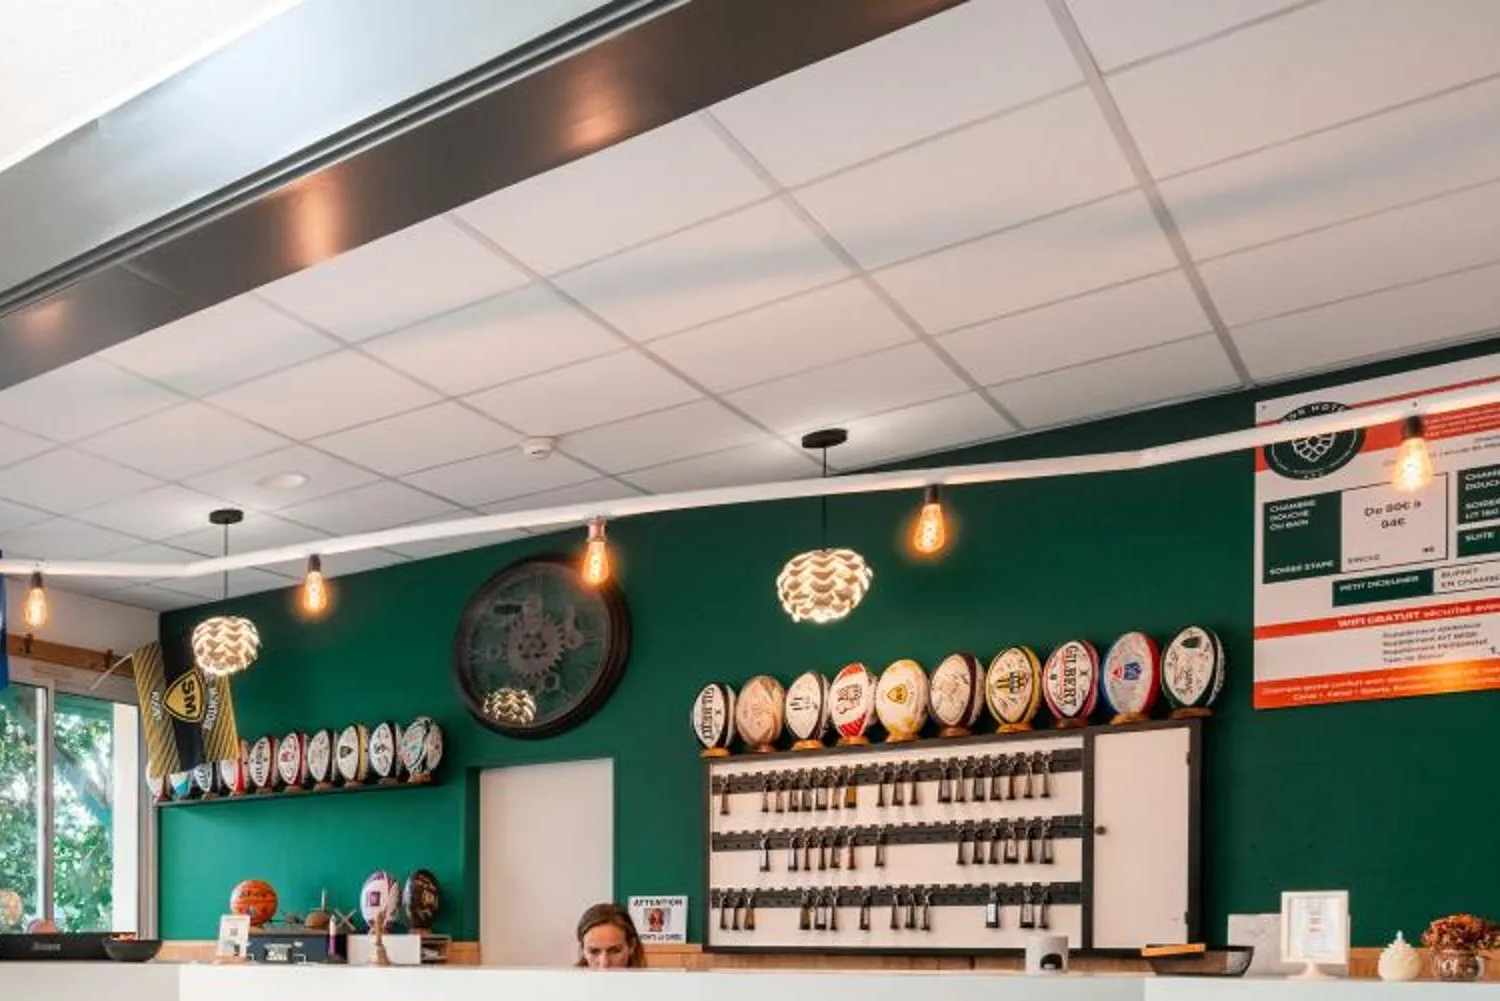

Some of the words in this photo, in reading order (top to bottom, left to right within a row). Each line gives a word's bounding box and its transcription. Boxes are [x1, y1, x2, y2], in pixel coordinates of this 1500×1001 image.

[1066, 645, 1078, 707] GILBERT
[181, 679, 197, 715] SM
[633, 898, 684, 907] ATTENTION
